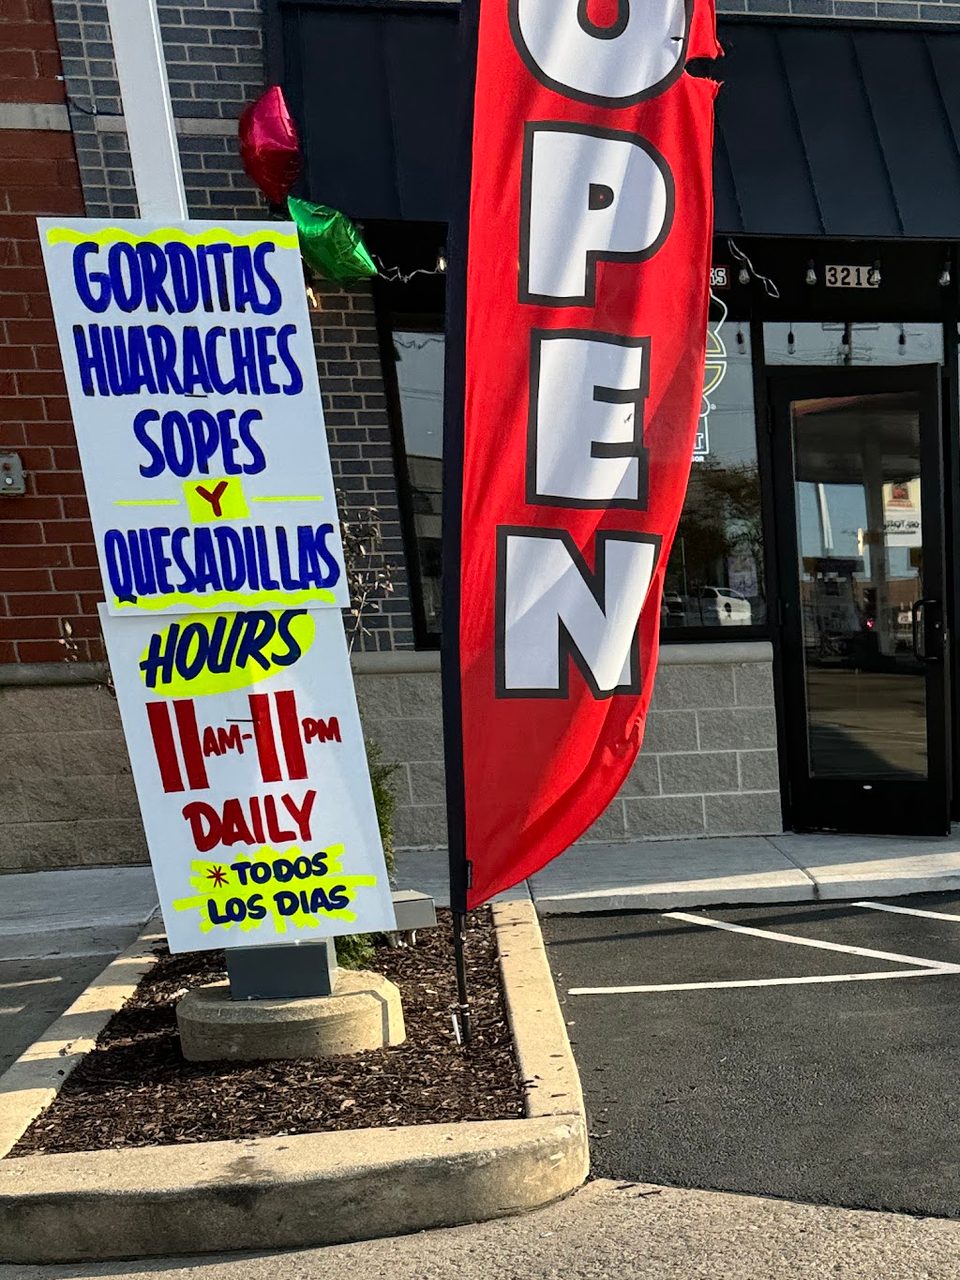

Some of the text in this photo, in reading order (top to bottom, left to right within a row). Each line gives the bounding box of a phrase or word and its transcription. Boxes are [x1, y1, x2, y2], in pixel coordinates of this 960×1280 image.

[73, 242, 281, 315] GORDITAS
[73, 324, 303, 396] HUARACHES
[495, 0, 694, 699] OPEN
[133, 409, 266, 478] SOPES
[195, 481, 228, 517] Y
[104, 523, 340, 604] QUESADILLAS
[139, 609, 307, 688] HOURS
[182, 790, 316, 852] DAILY
[230, 852, 328, 886] TODOS
[207, 885, 349, 925] LOS DIAS
